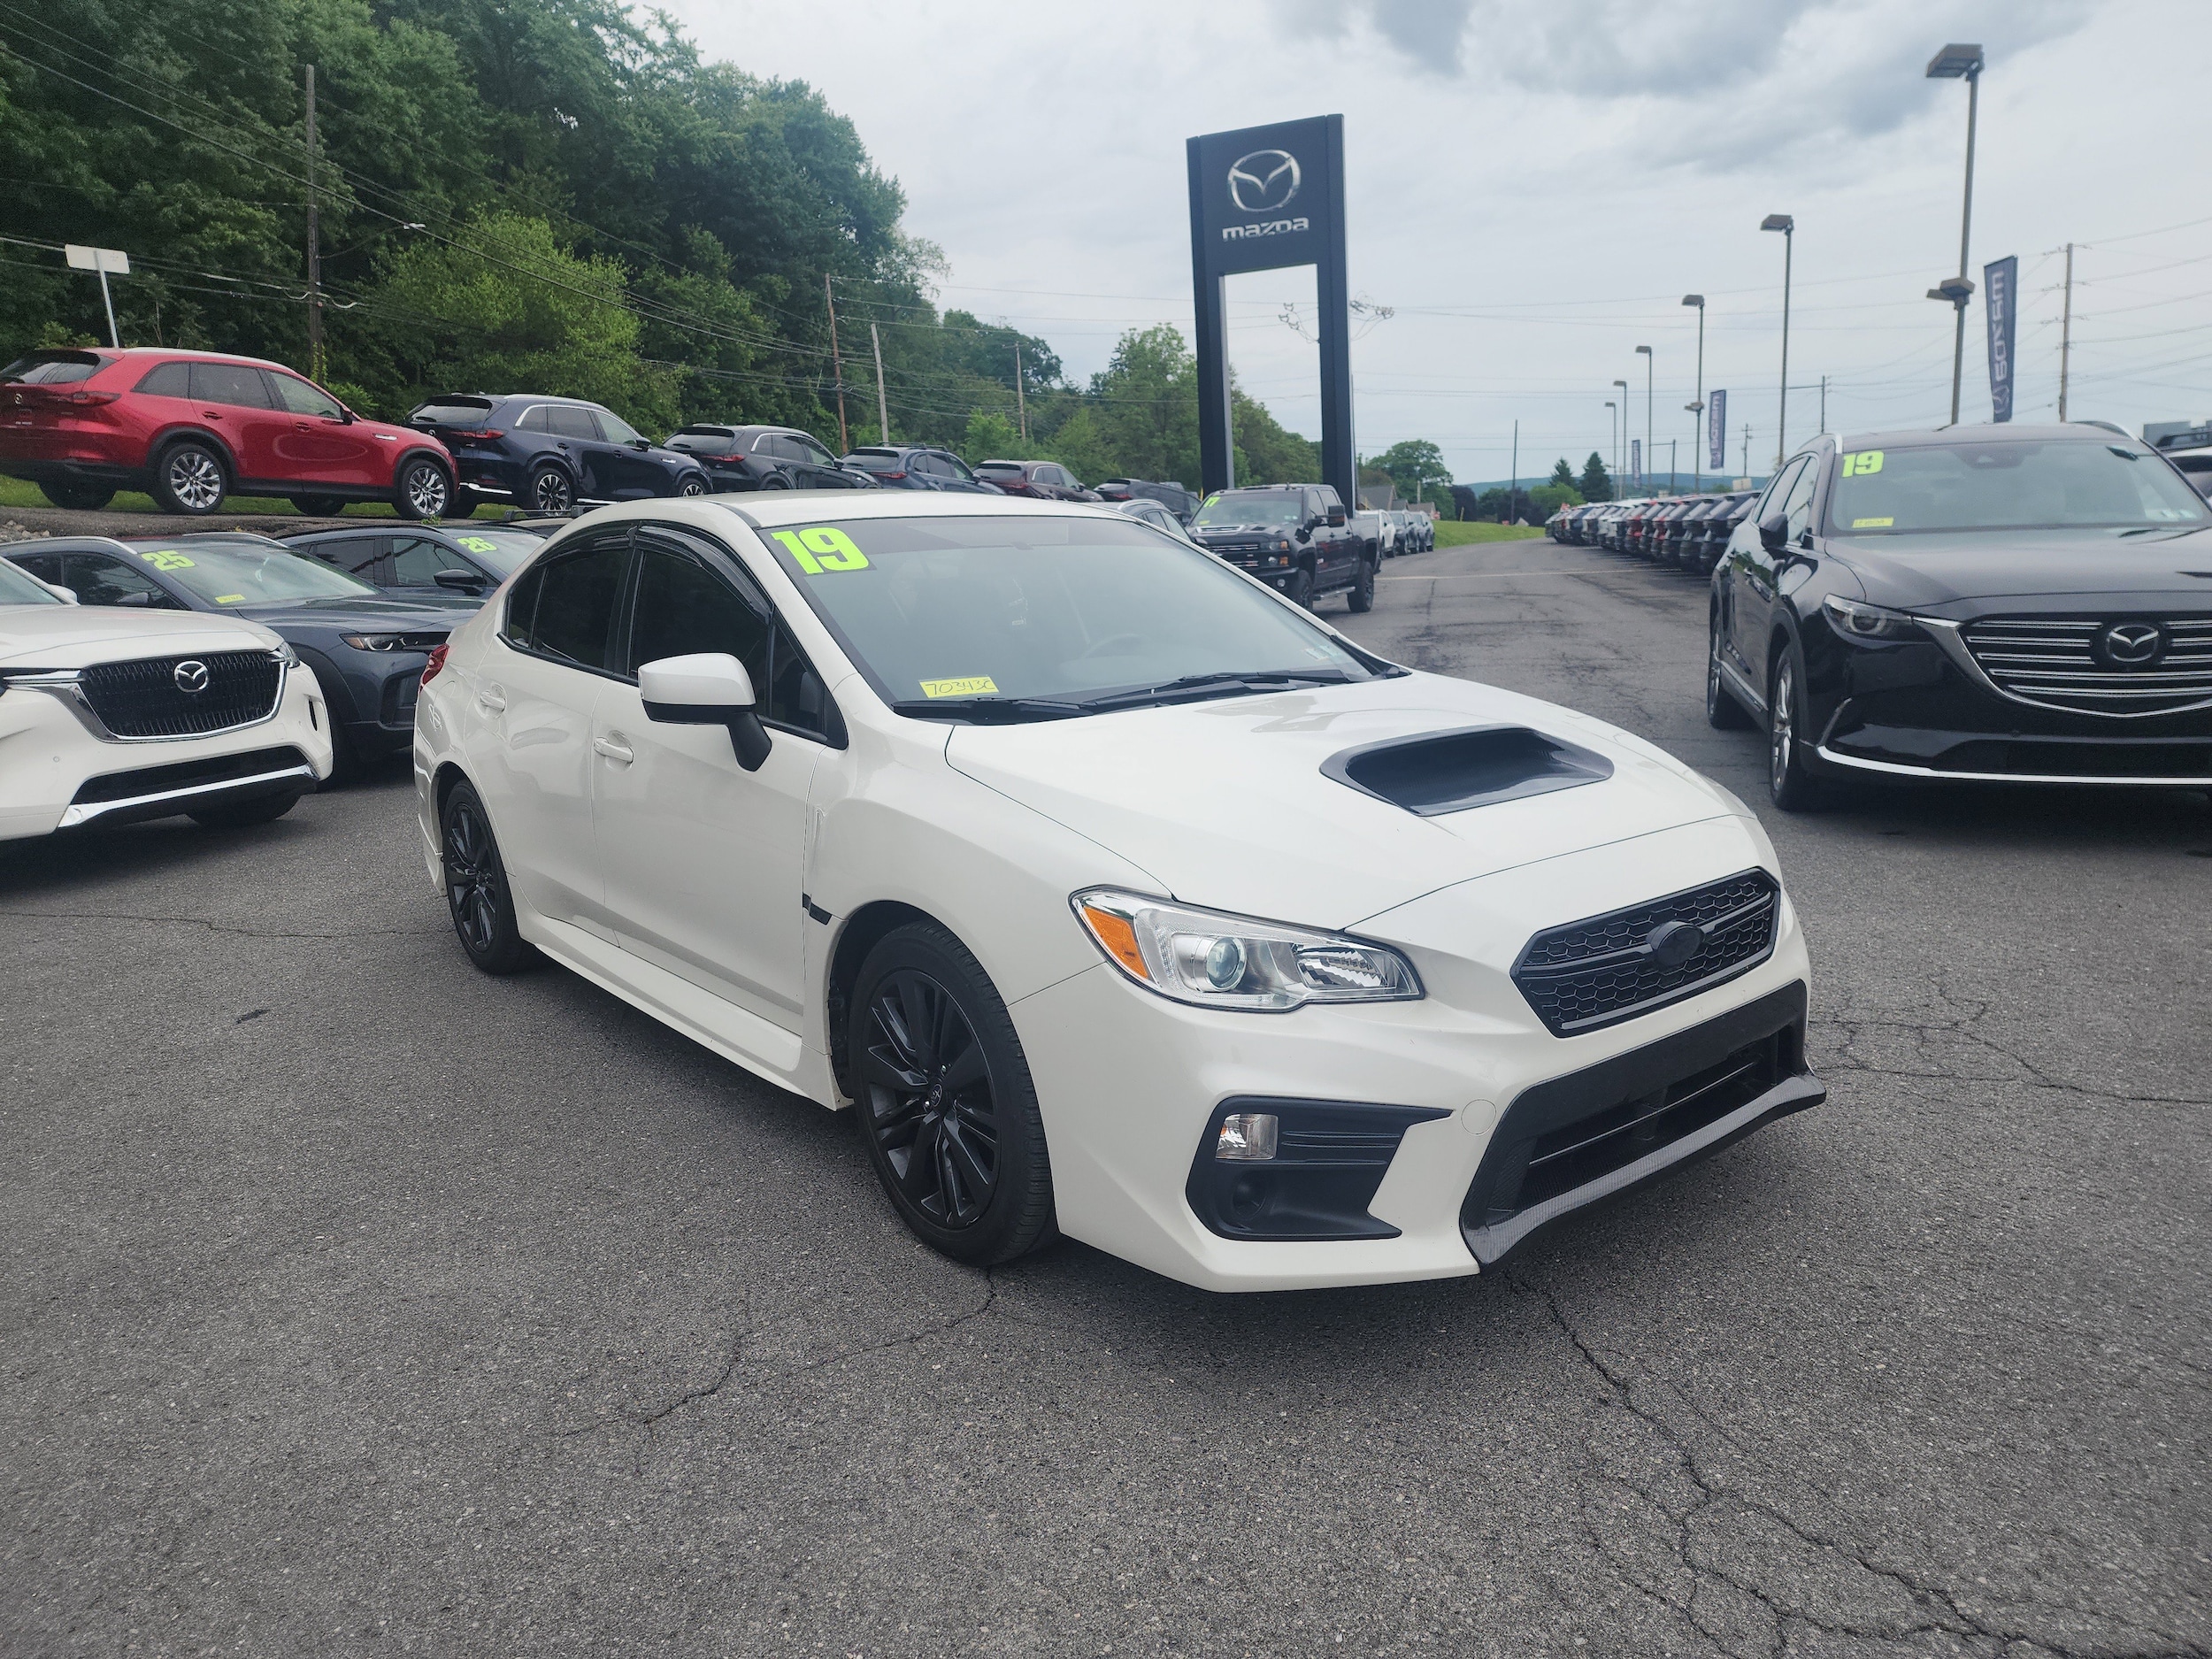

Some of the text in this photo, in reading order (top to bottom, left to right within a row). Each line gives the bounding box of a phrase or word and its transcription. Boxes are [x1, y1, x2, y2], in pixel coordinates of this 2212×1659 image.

[1222, 217, 1310, 242] mazda
[1841, 450, 1885, 478] 19
[457, 536, 497, 553] 26
[770, 527, 870, 574] 19
[142, 549, 196, 572] 25
